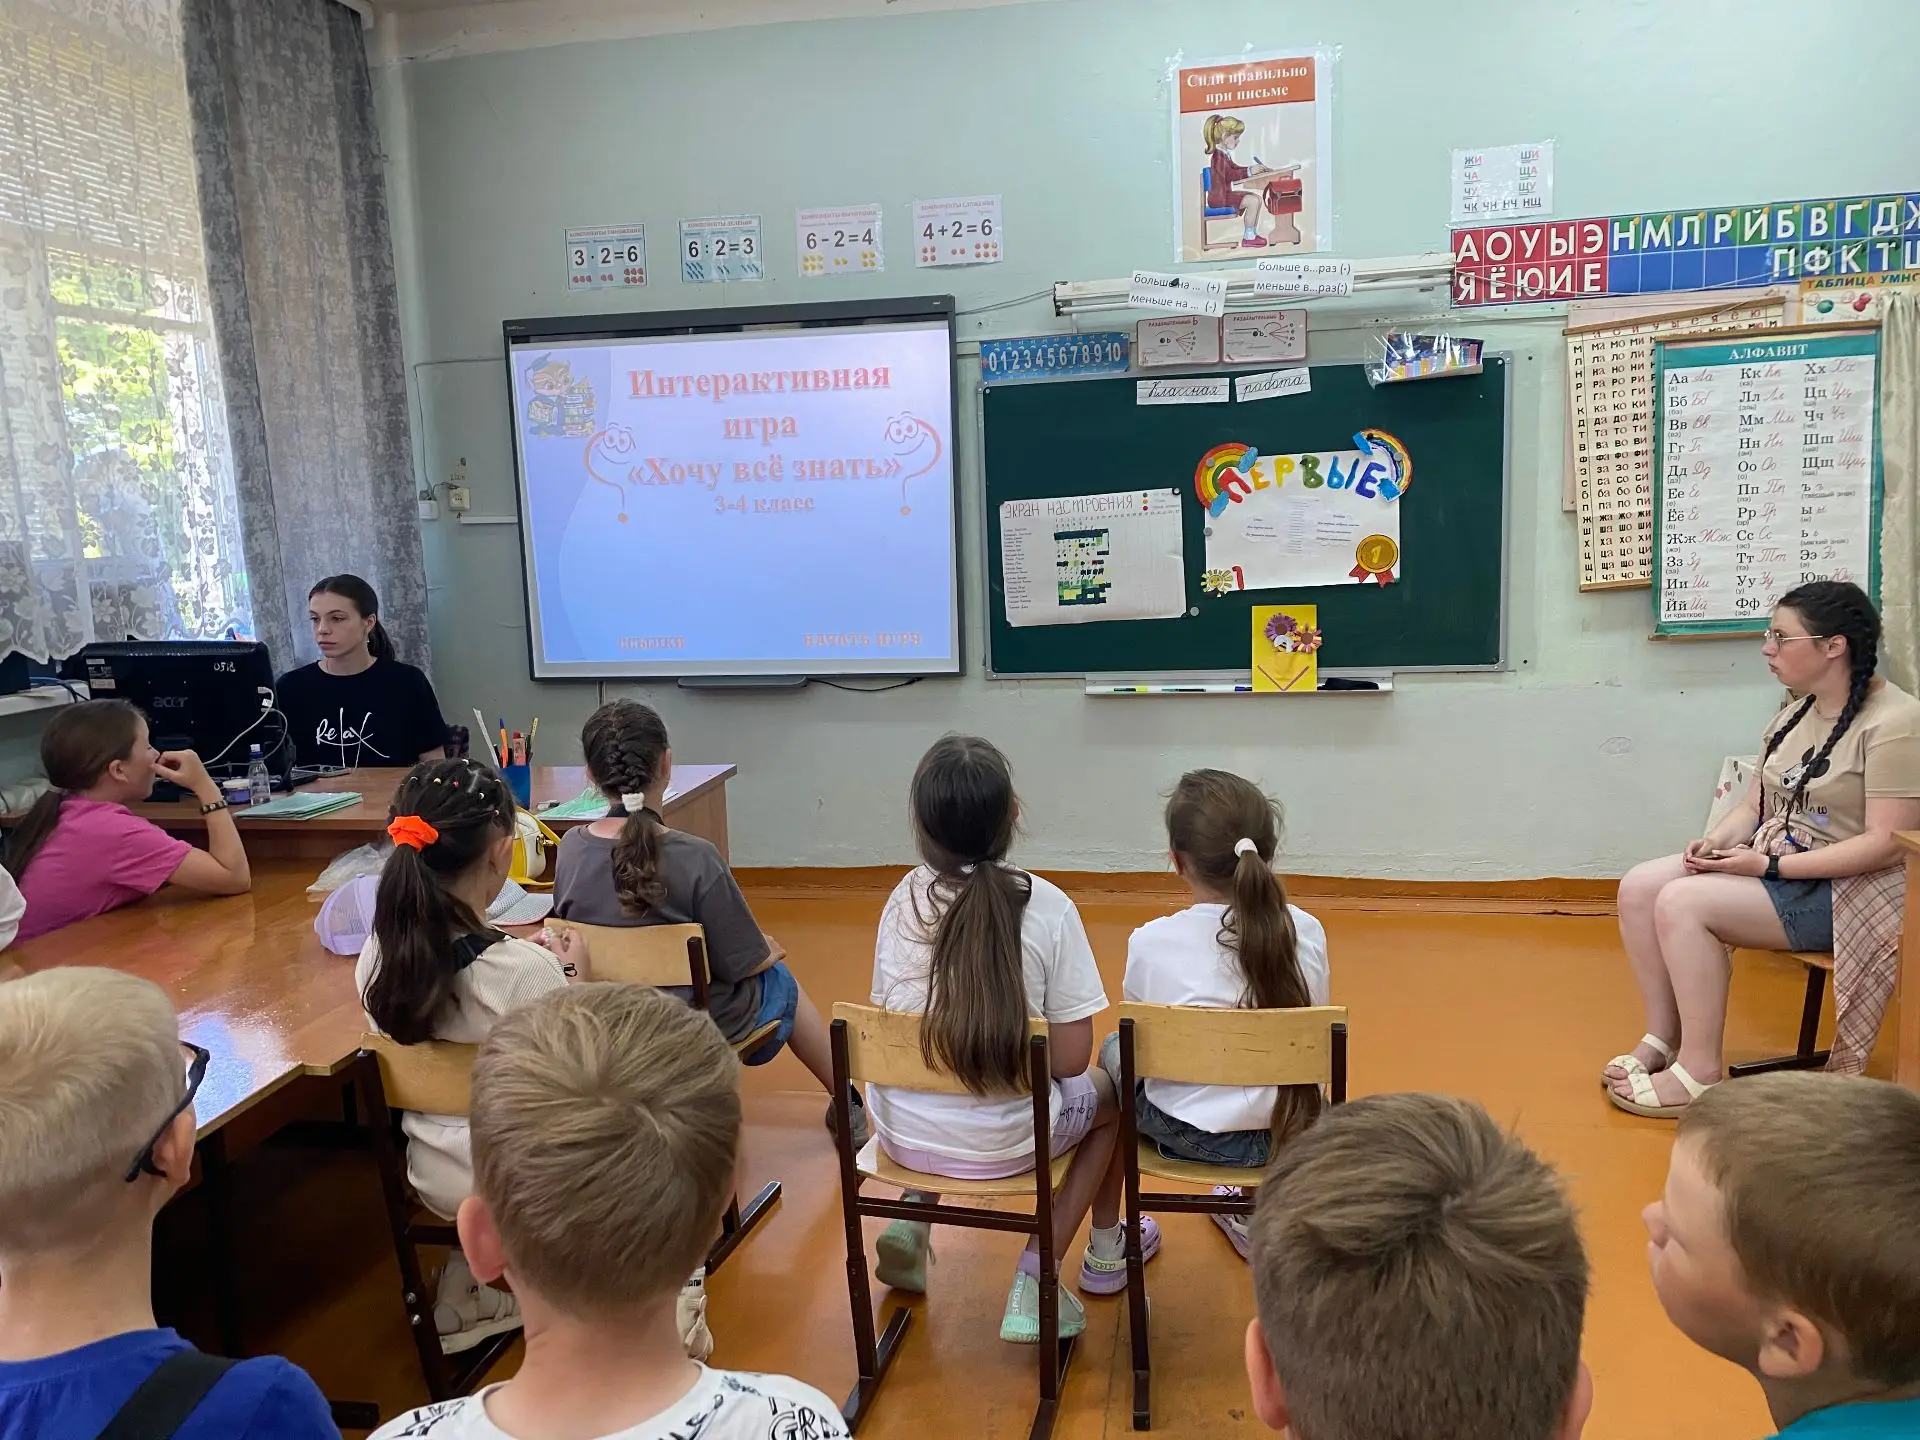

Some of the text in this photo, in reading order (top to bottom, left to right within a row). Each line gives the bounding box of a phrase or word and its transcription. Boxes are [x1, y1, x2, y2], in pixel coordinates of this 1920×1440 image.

[1186, 66, 1308, 88] Сиди правильно
[1205, 85, 1289, 106] при письме
[1464, 150, 1539, 165] ЖИ ШИ
[1464, 166, 1538, 181] ЧА ЩА
[1464, 187, 1478, 196] ЧУ
[1464, 202, 1478, 212] ЧК
[1482, 201, 1498, 211] ЧН
[1503, 199, 1518, 209] НЧ
[923, 222, 935, 240] 4
[951, 220, 964, 238] 2
[980, 218, 993, 236] 6
[688, 240, 699, 258] 6
[715, 239, 726, 256] 2
[743, 237, 754, 255] 3
[805, 232, 818, 250] 6
[833, 230, 846, 248] 2
[861, 228, 874, 246] 4
[574, 249, 585, 266] 3
[600, 247, 612, 264] 2
[627, 245, 639, 263] 6
[1259, 261, 1300, 272] больше
[1206, 281, 1221, 294] (+)
[1256, 282, 1300, 291] меньше
[1807, 273, 1875, 289] ТАБЛИЦА
[1130, 294, 1173, 307] меньше
[1105, 342, 1121, 362] 10
[1591, 342, 1606, 351] ма
[1610, 339, 1626, 348] мо
[1630, 337, 1645, 346] ми
[1729, 343, 1809, 360] АЛФАВИТ
[628, 364, 891, 401] Интерактивная
[1148, 371, 1305, 400] Классная работа
[723, 416, 798, 444] игра
[627, 454, 904, 490] «Хочу всё знать»
[1217, 454, 1387, 503] ПЕРВЫЕ
[715, 495, 816, 513] 3-4 класс
[1004, 501, 1040, 519] ЭКРАН
[1371, 545, 1382, 564] 1
